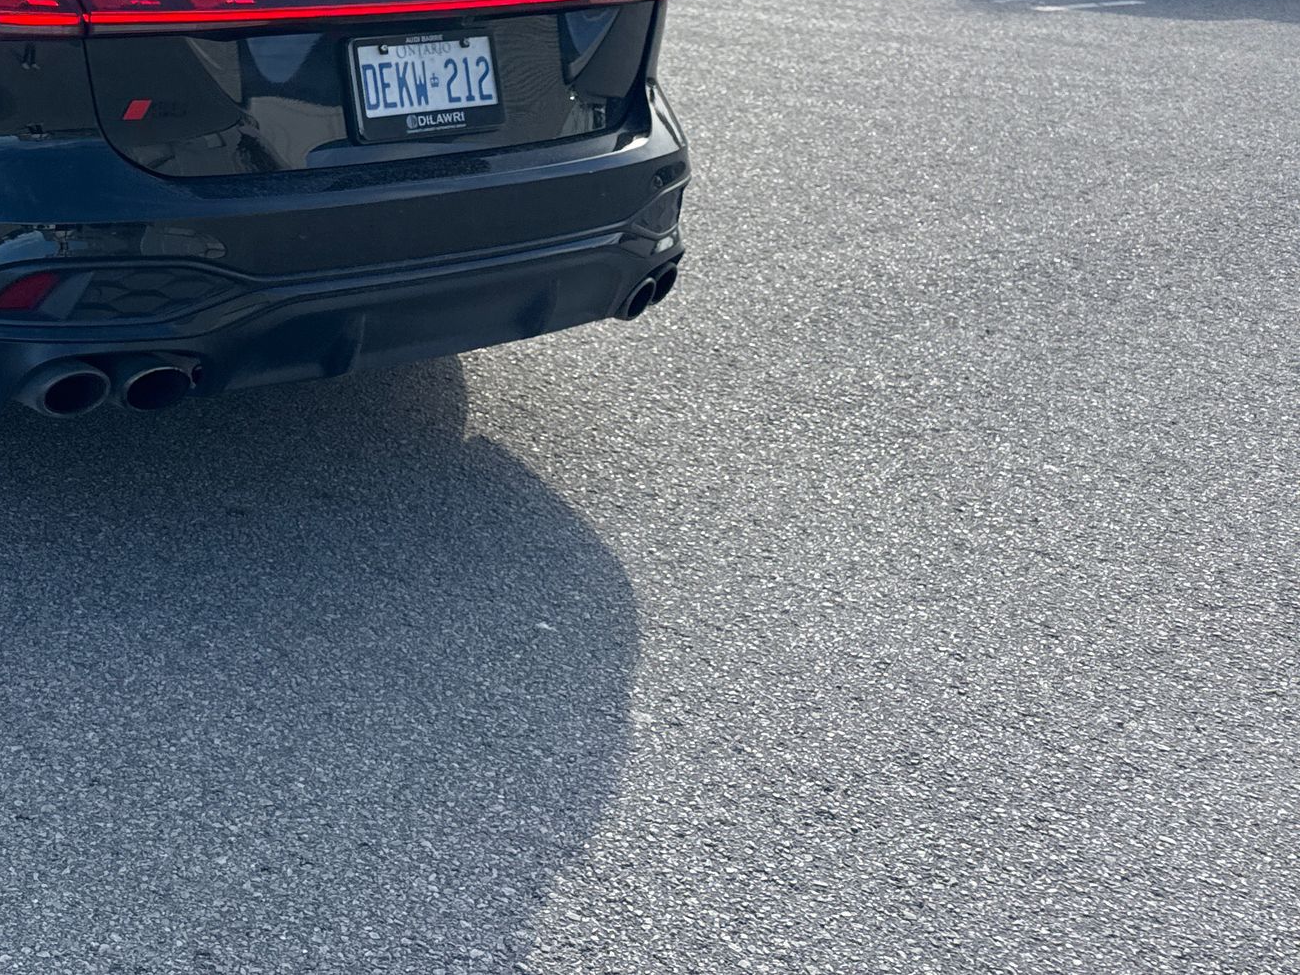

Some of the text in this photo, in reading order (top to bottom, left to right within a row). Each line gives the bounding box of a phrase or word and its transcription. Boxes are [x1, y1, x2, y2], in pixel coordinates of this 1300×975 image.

[396, 41, 451, 59] ONTARIO
[361, 55, 493, 110] DEKW 212
[418, 111, 466, 127] DILAWRI
